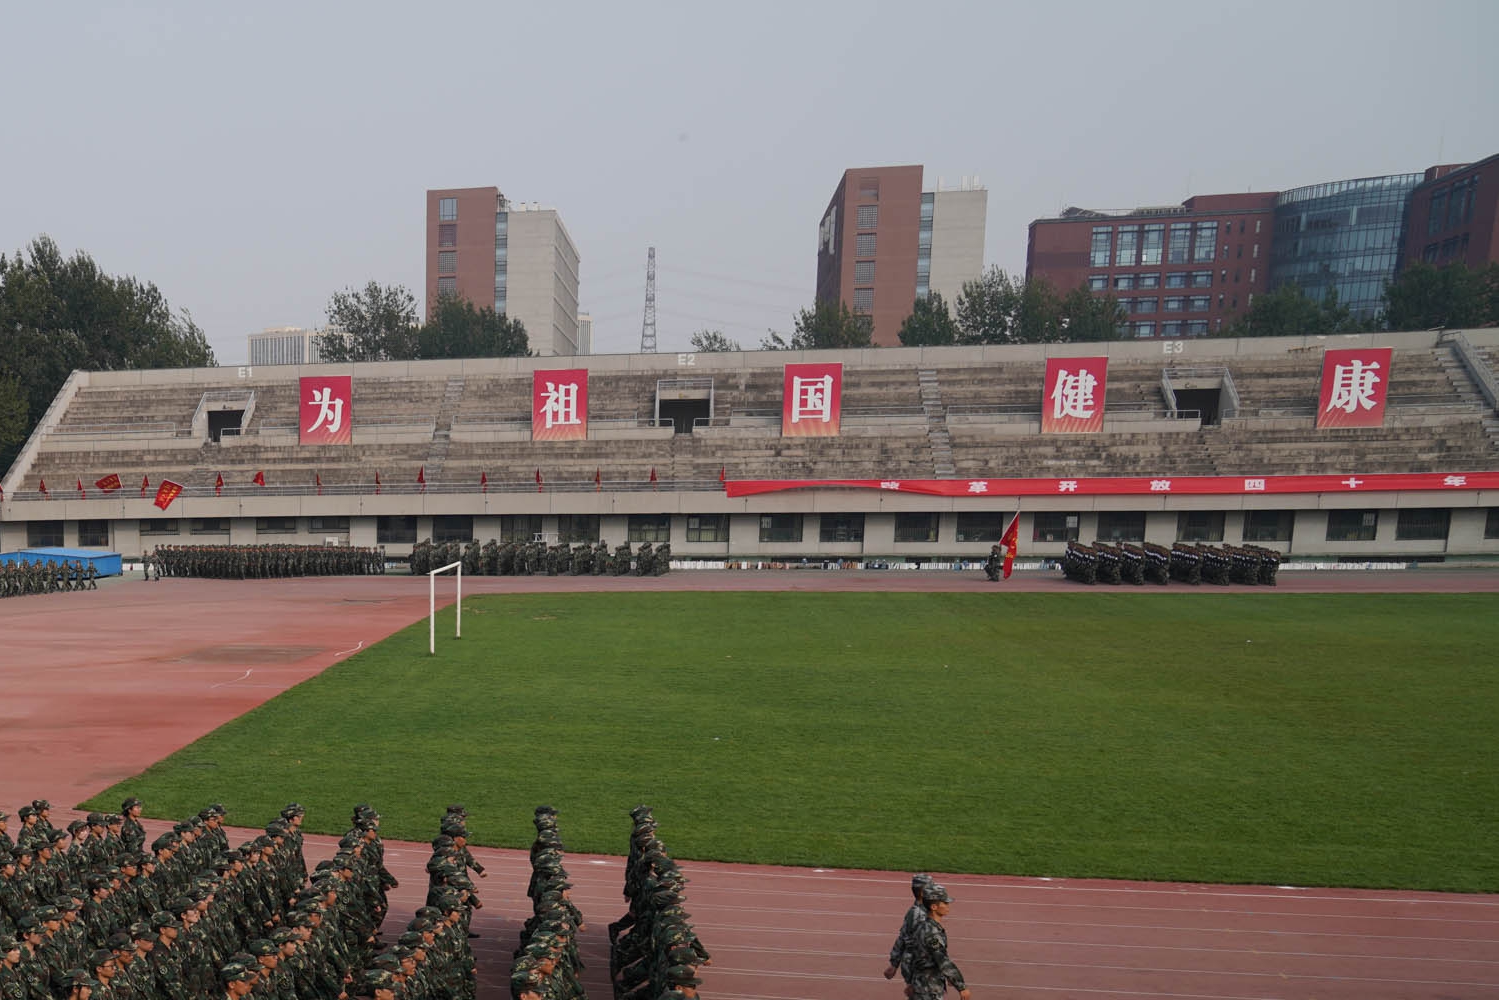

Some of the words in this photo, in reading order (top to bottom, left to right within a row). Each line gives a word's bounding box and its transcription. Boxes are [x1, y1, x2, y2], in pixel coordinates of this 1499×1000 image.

[677, 353, 696, 366] E2
[1163, 340, 1184, 355] E3
[238, 367, 252, 378] E1
[1051, 369, 1098, 419] 健
[1326, 359, 1381, 413] 康
[307, 387, 344, 433] 为
[540, 382, 582, 429] 祖
[791, 374, 834, 424] 国
